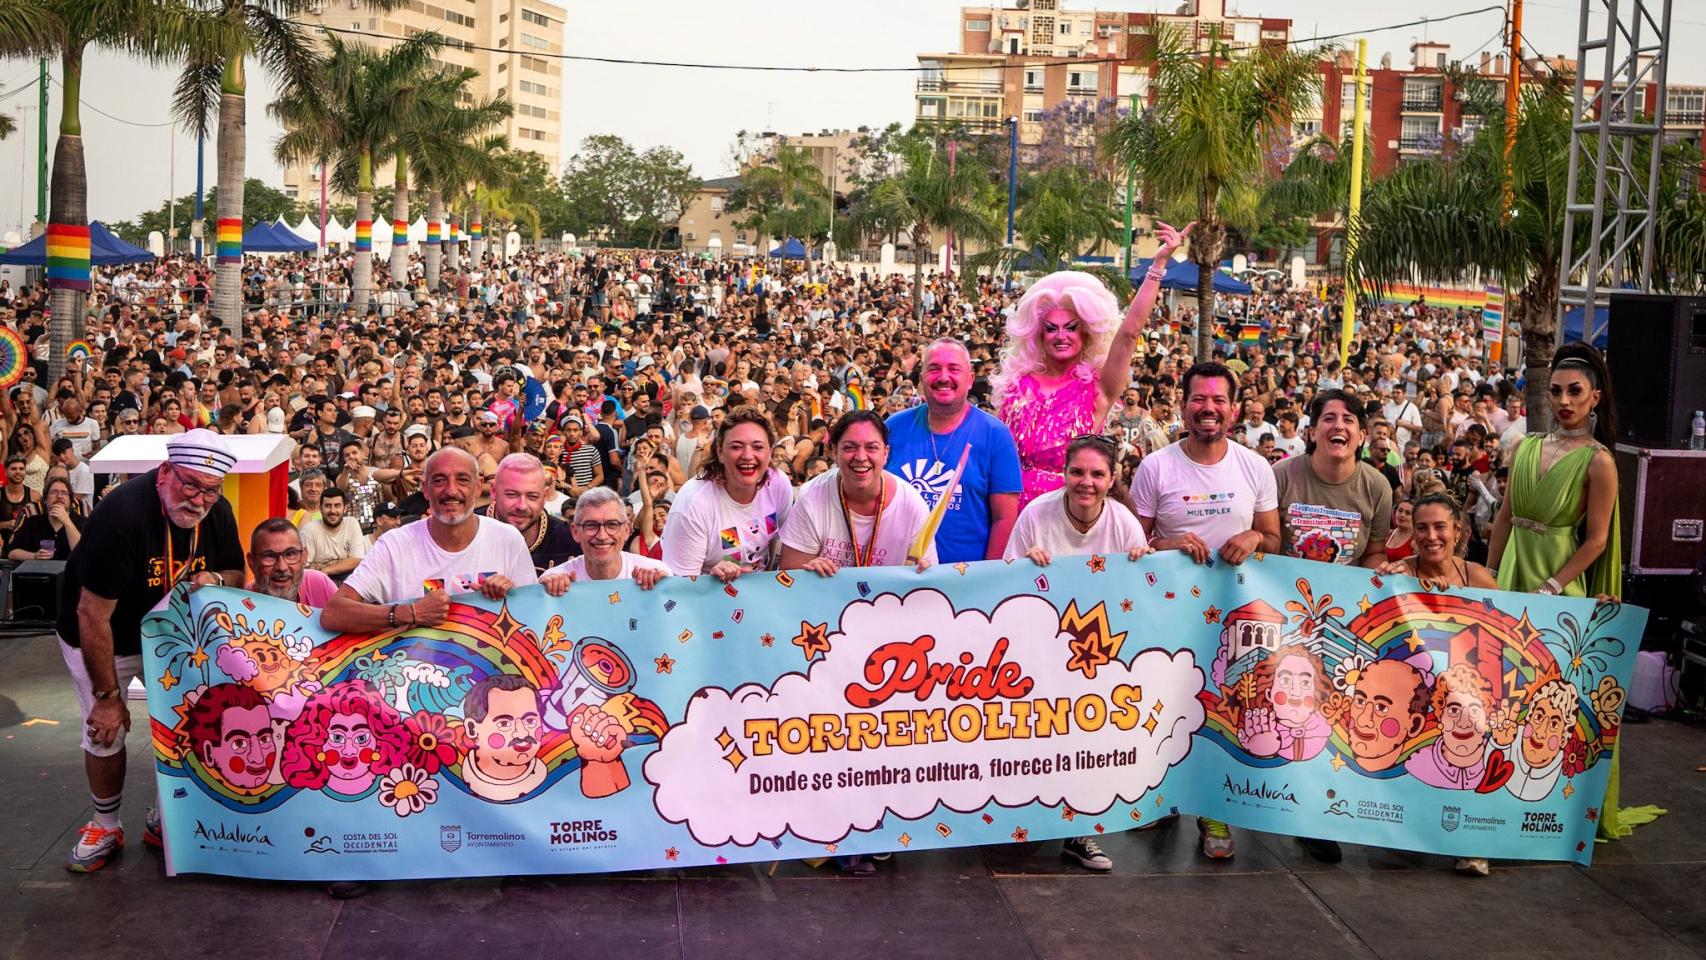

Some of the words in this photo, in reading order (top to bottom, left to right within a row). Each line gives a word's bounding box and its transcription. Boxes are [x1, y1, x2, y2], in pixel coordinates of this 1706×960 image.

[1187, 507, 1231, 516] MULTIPLEX
[844, 634, 1034, 707] Pride
[744, 684, 1142, 756] TORREMOLINOS
[750, 770, 808, 794] Donde
[811, 773, 833, 790] se
[837, 762, 911, 788] siembra
[915, 760, 983, 784] cultura,
[989, 752, 1053, 779] florece
[1056, 753, 1071, 772] la
[1075, 747, 1137, 771] libertad
[1223, 773, 1300, 805] Andalucía
[1358, 800, 1377, 809] COSTA
[1379, 803, 1390, 811] DEL
[1357, 807, 1403, 820] OCCIDENTAL
[1524, 812, 1557, 823] TORRE
[1463, 814, 1506, 826] Torremolinos
[550, 820, 602, 833] TORRE
[1521, 822, 1564, 833] MOLINOS
[193, 820, 276, 847] Andalucía
[343, 833, 366, 841] COSTA
[368, 833, 381, 841] DEL
[383, 832, 398, 840] SOL
[466, 831, 526, 841] Torremolinos
[550, 829, 618, 845] MOLINOS
[343, 840, 398, 849] OCCIDENTAL
